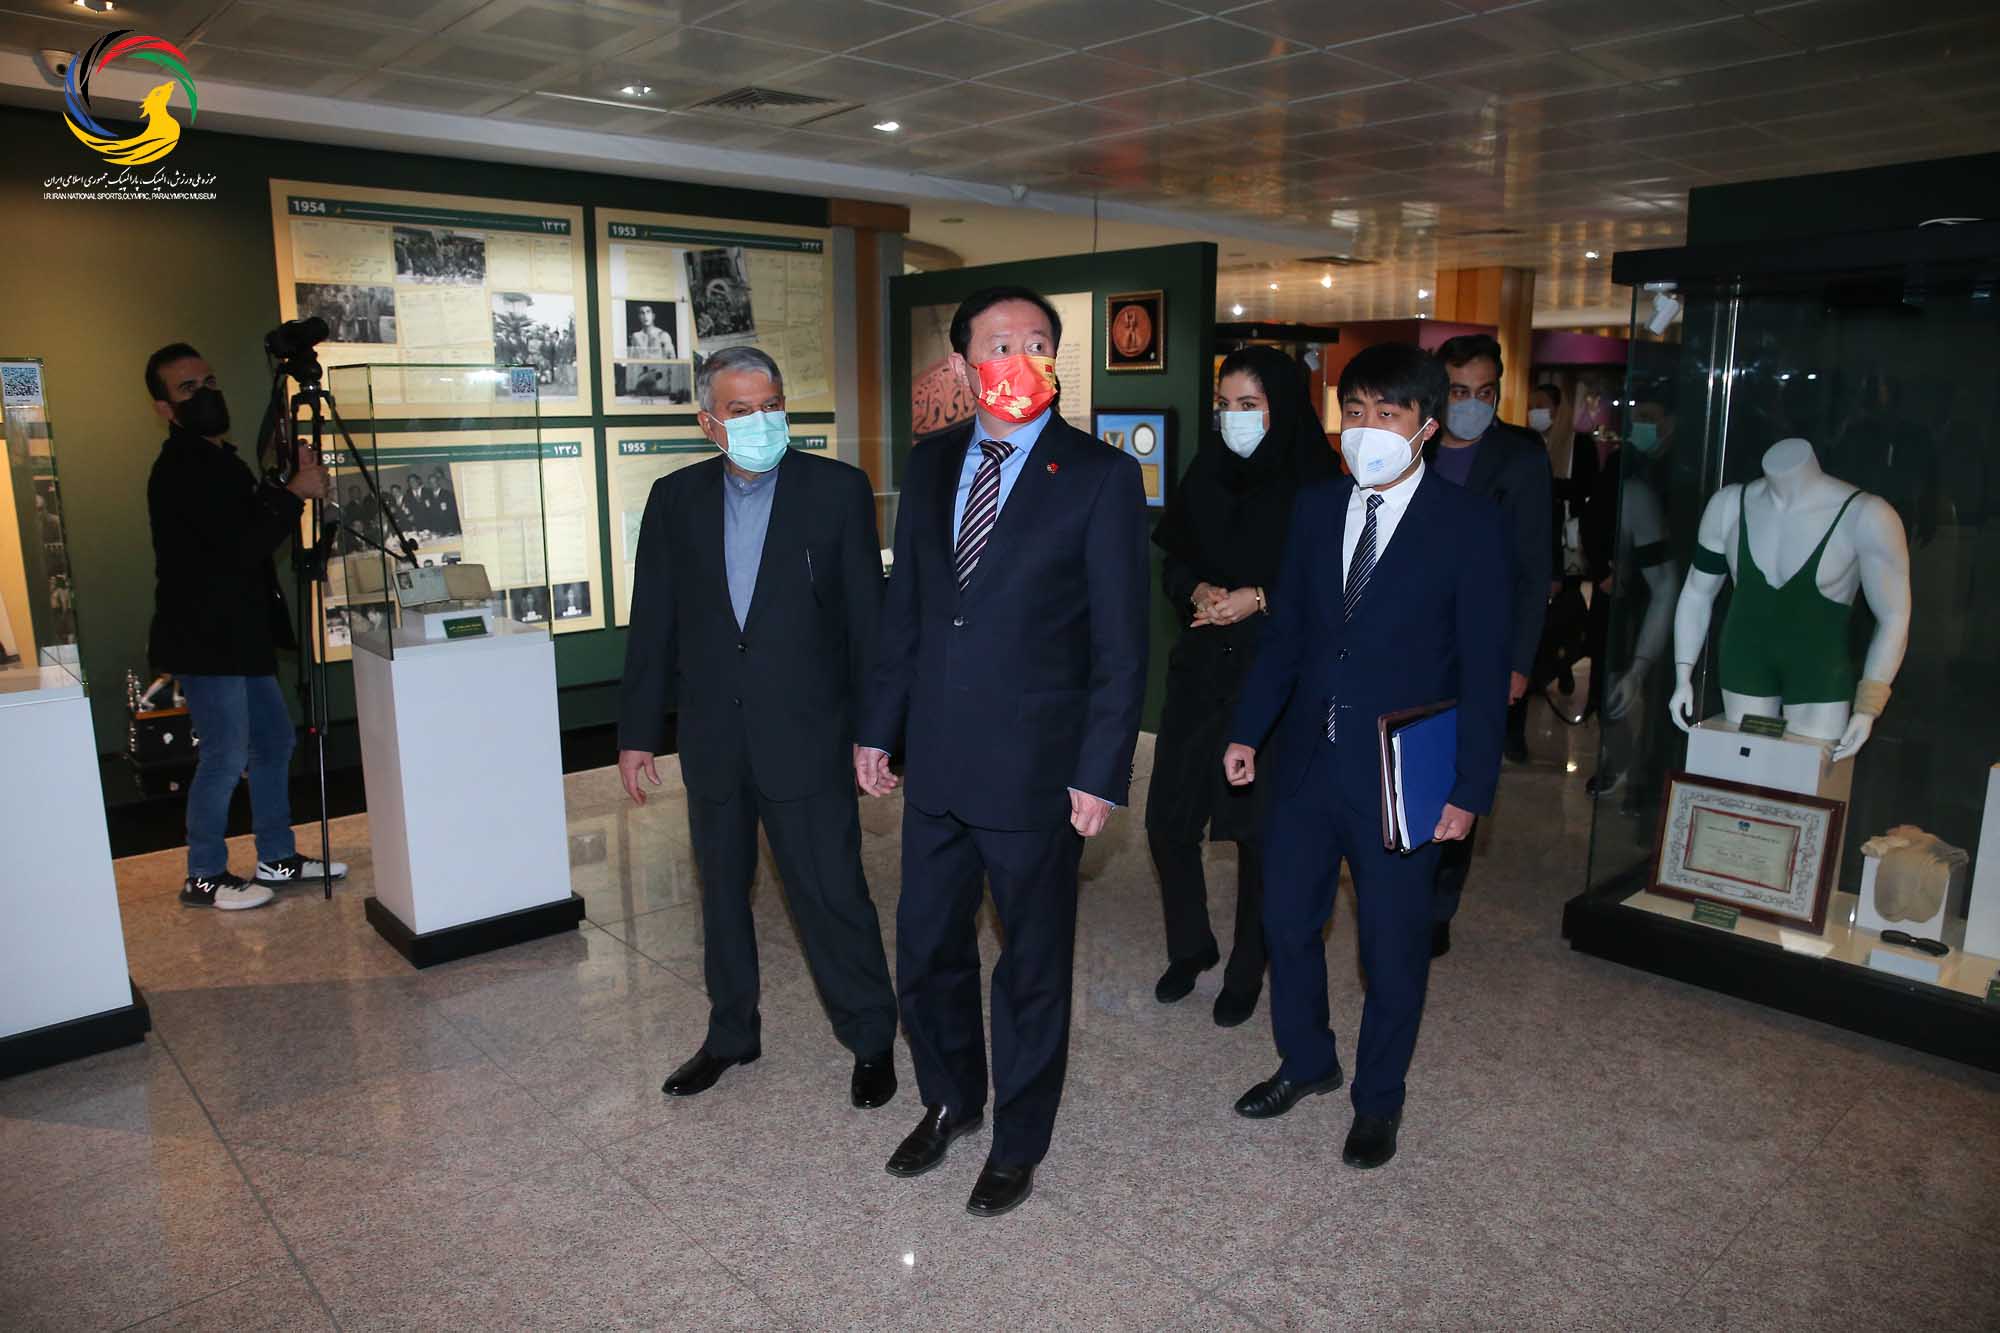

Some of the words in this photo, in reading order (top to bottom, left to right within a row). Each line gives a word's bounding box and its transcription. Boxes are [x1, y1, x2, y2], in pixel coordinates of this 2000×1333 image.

[293, 201, 326, 213] 1954
[612, 225, 636, 237] 1953
[621, 442, 646, 453] 1955
[322, 452, 345, 465] 956
